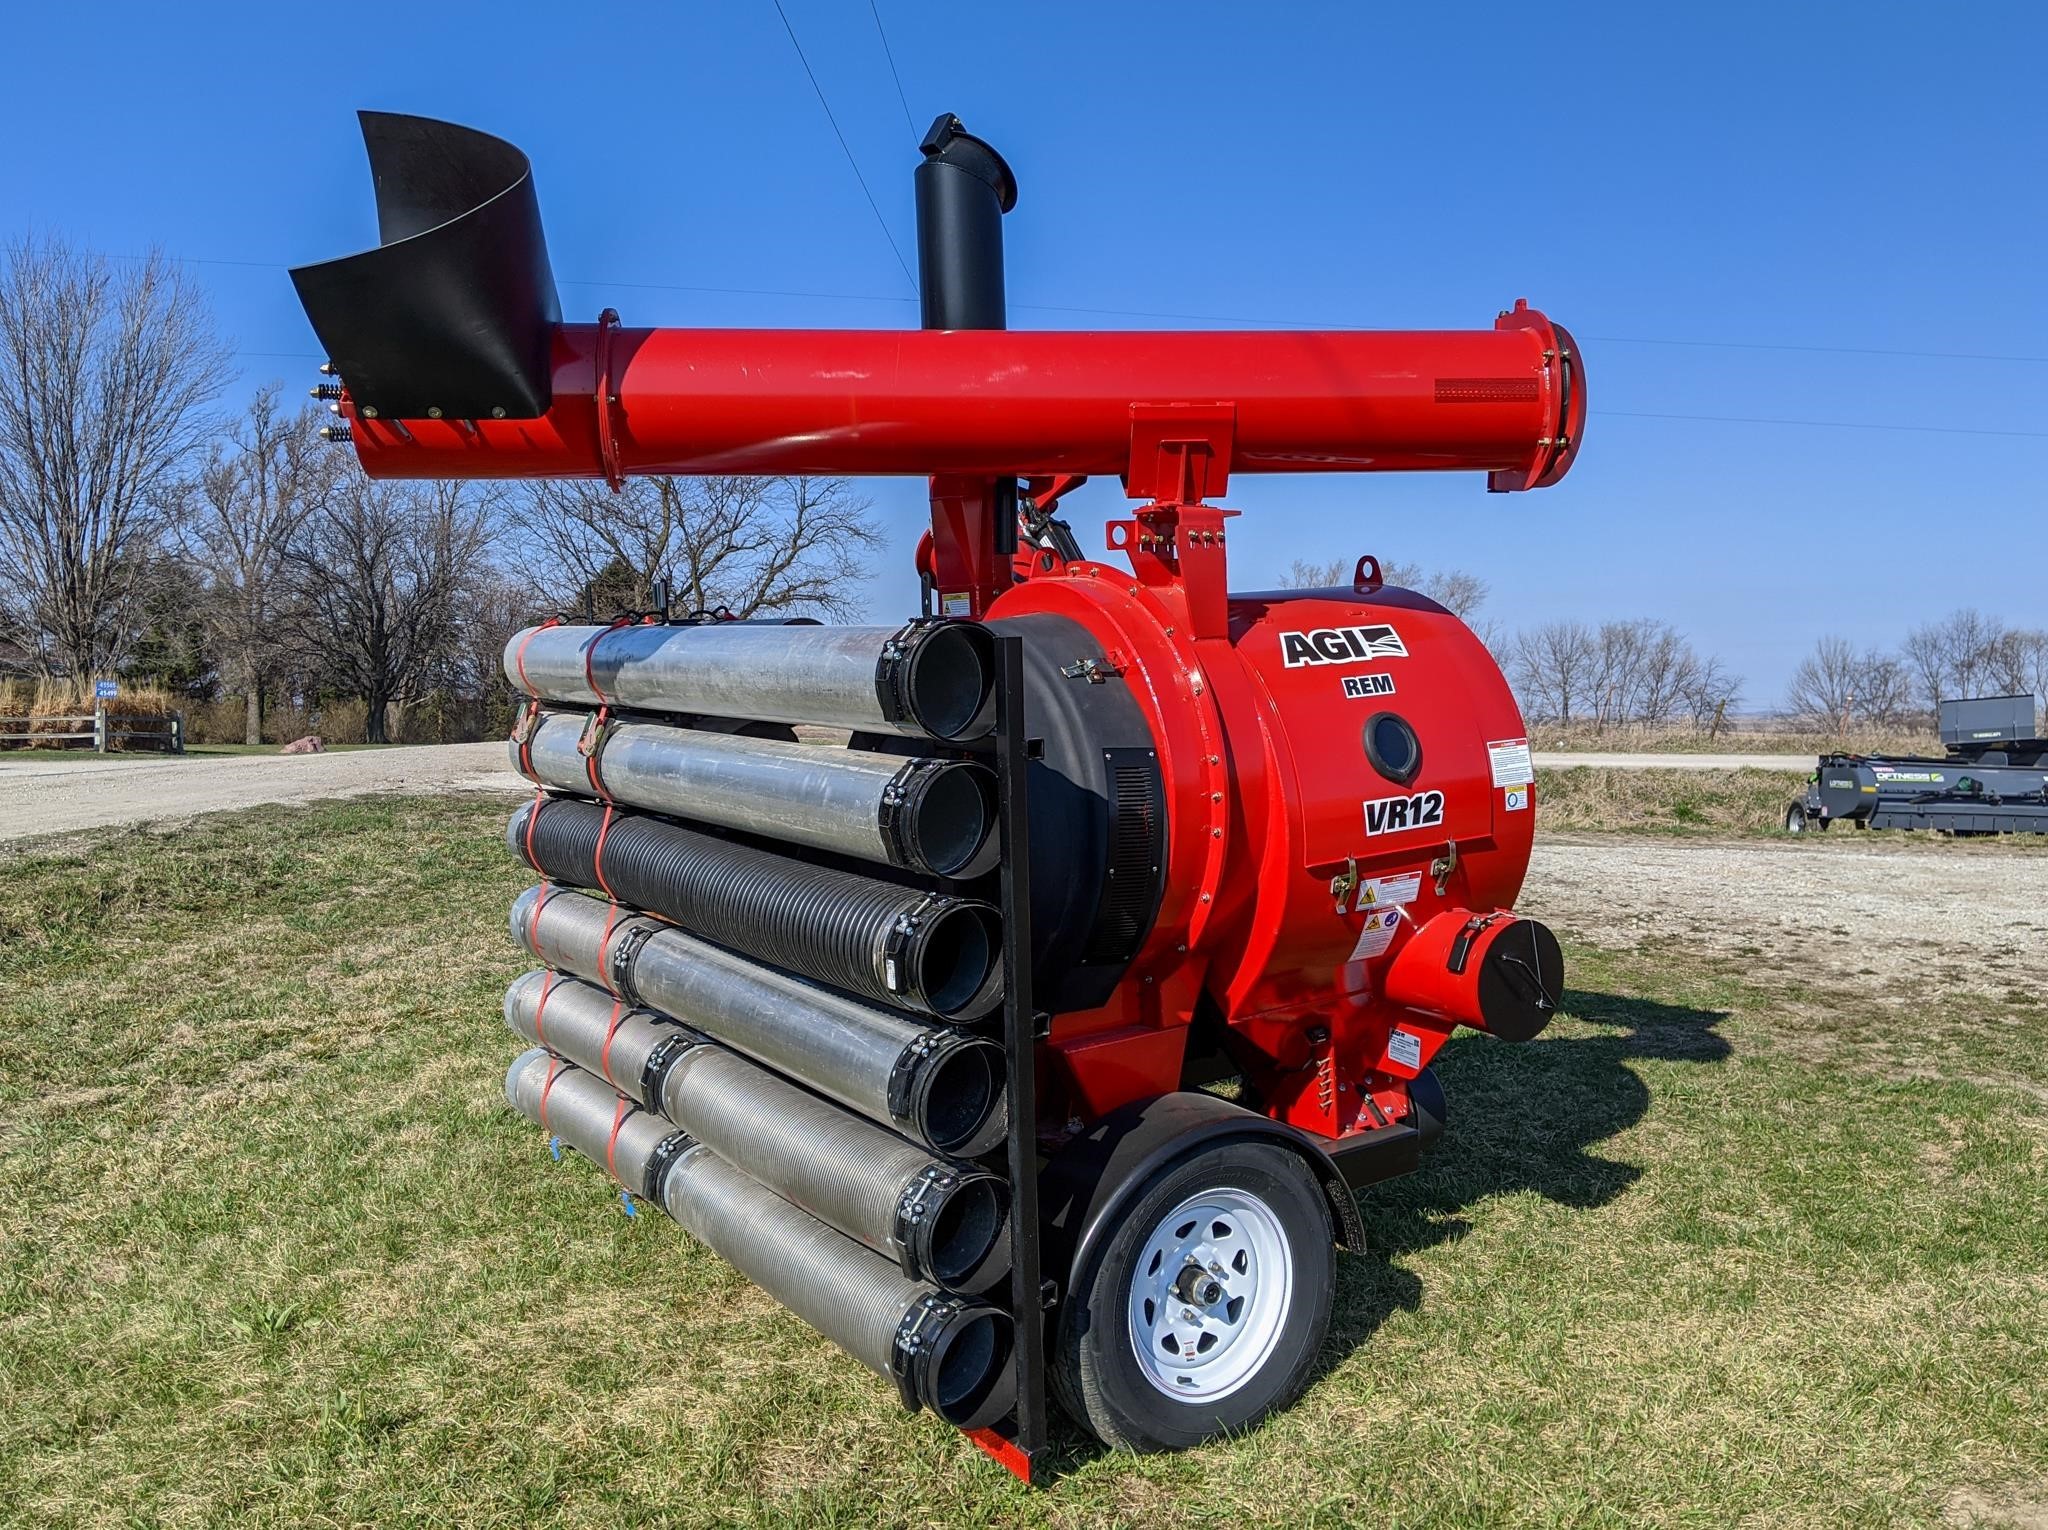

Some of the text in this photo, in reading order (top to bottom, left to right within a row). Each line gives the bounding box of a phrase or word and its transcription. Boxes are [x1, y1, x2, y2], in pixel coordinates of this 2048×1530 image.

[1284, 629, 1368, 664] AGI
[1343, 675, 1394, 697] REM
[1366, 793, 1442, 833] VR12
